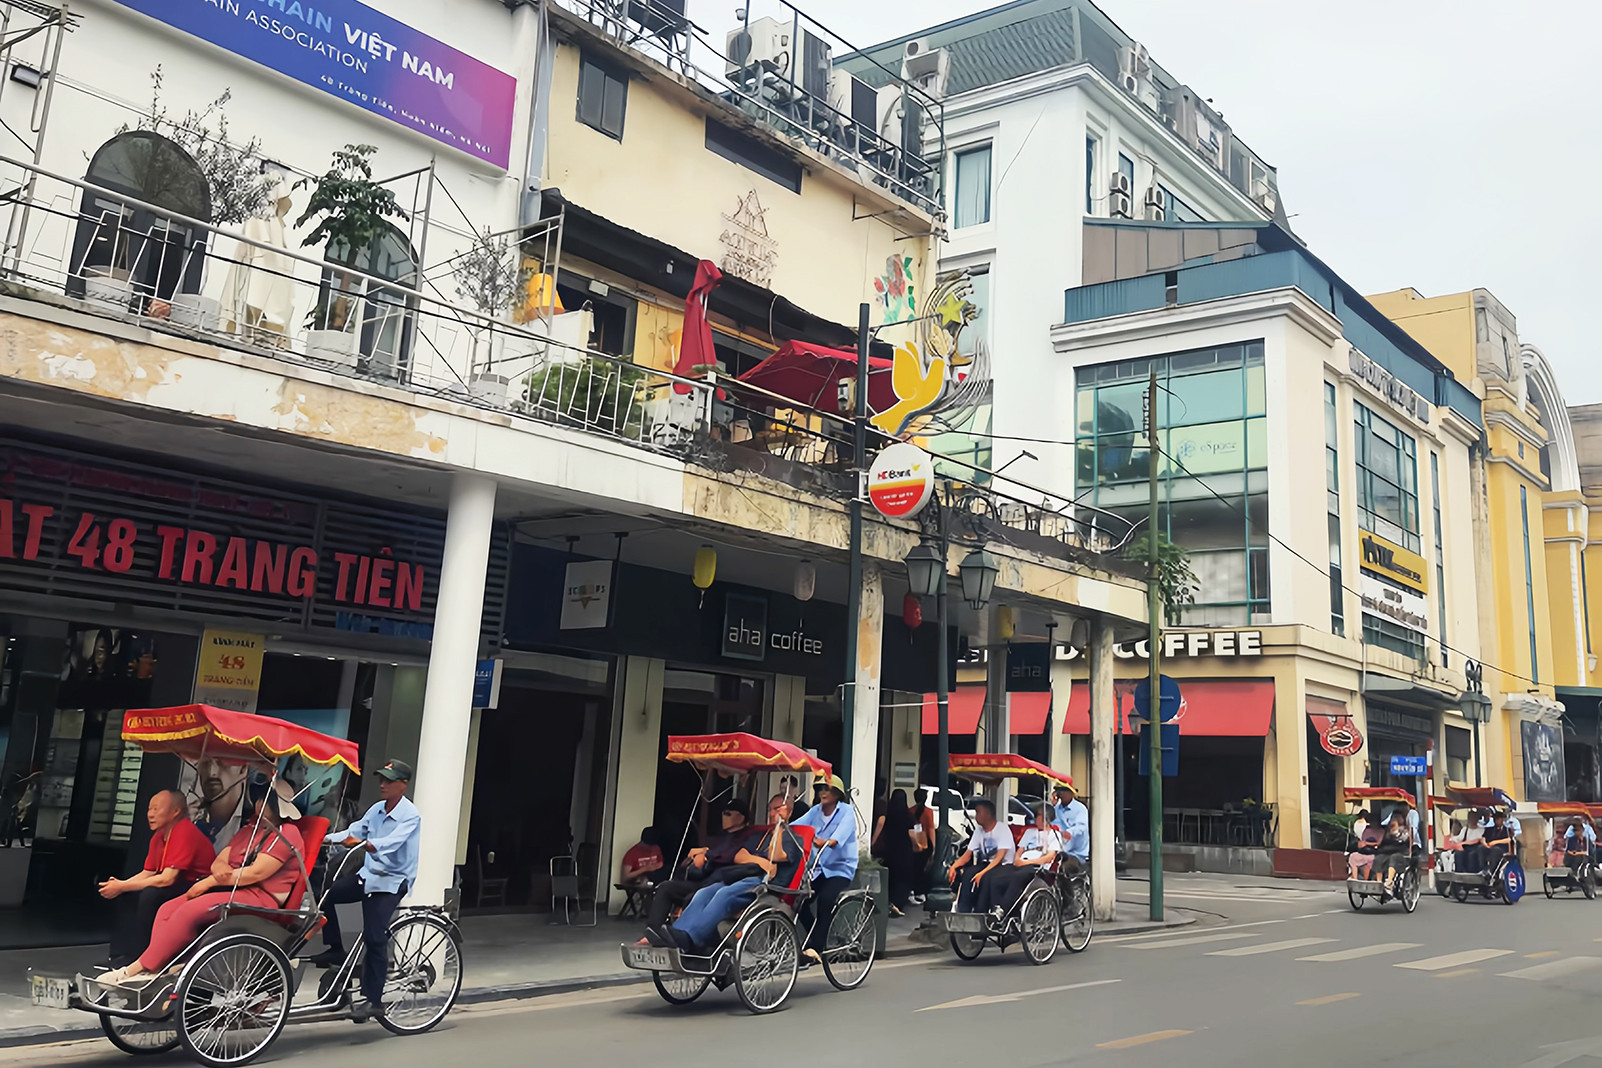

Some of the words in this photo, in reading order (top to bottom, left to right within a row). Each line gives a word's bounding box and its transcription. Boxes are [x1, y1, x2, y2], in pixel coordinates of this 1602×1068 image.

[245, 9, 368, 74] ASSOCIATION
[343, 22, 398, 61] VIỆT
[402, 51, 455, 90] NAM
[67, 512, 137, 573] 48
[156, 525, 318, 597] TRANG
[335, 547, 424, 611] TIÊN
[729, 618, 761, 646] aha
[771, 631, 823, 655] coffee
[1113, 631, 1262, 658] COFFEE
